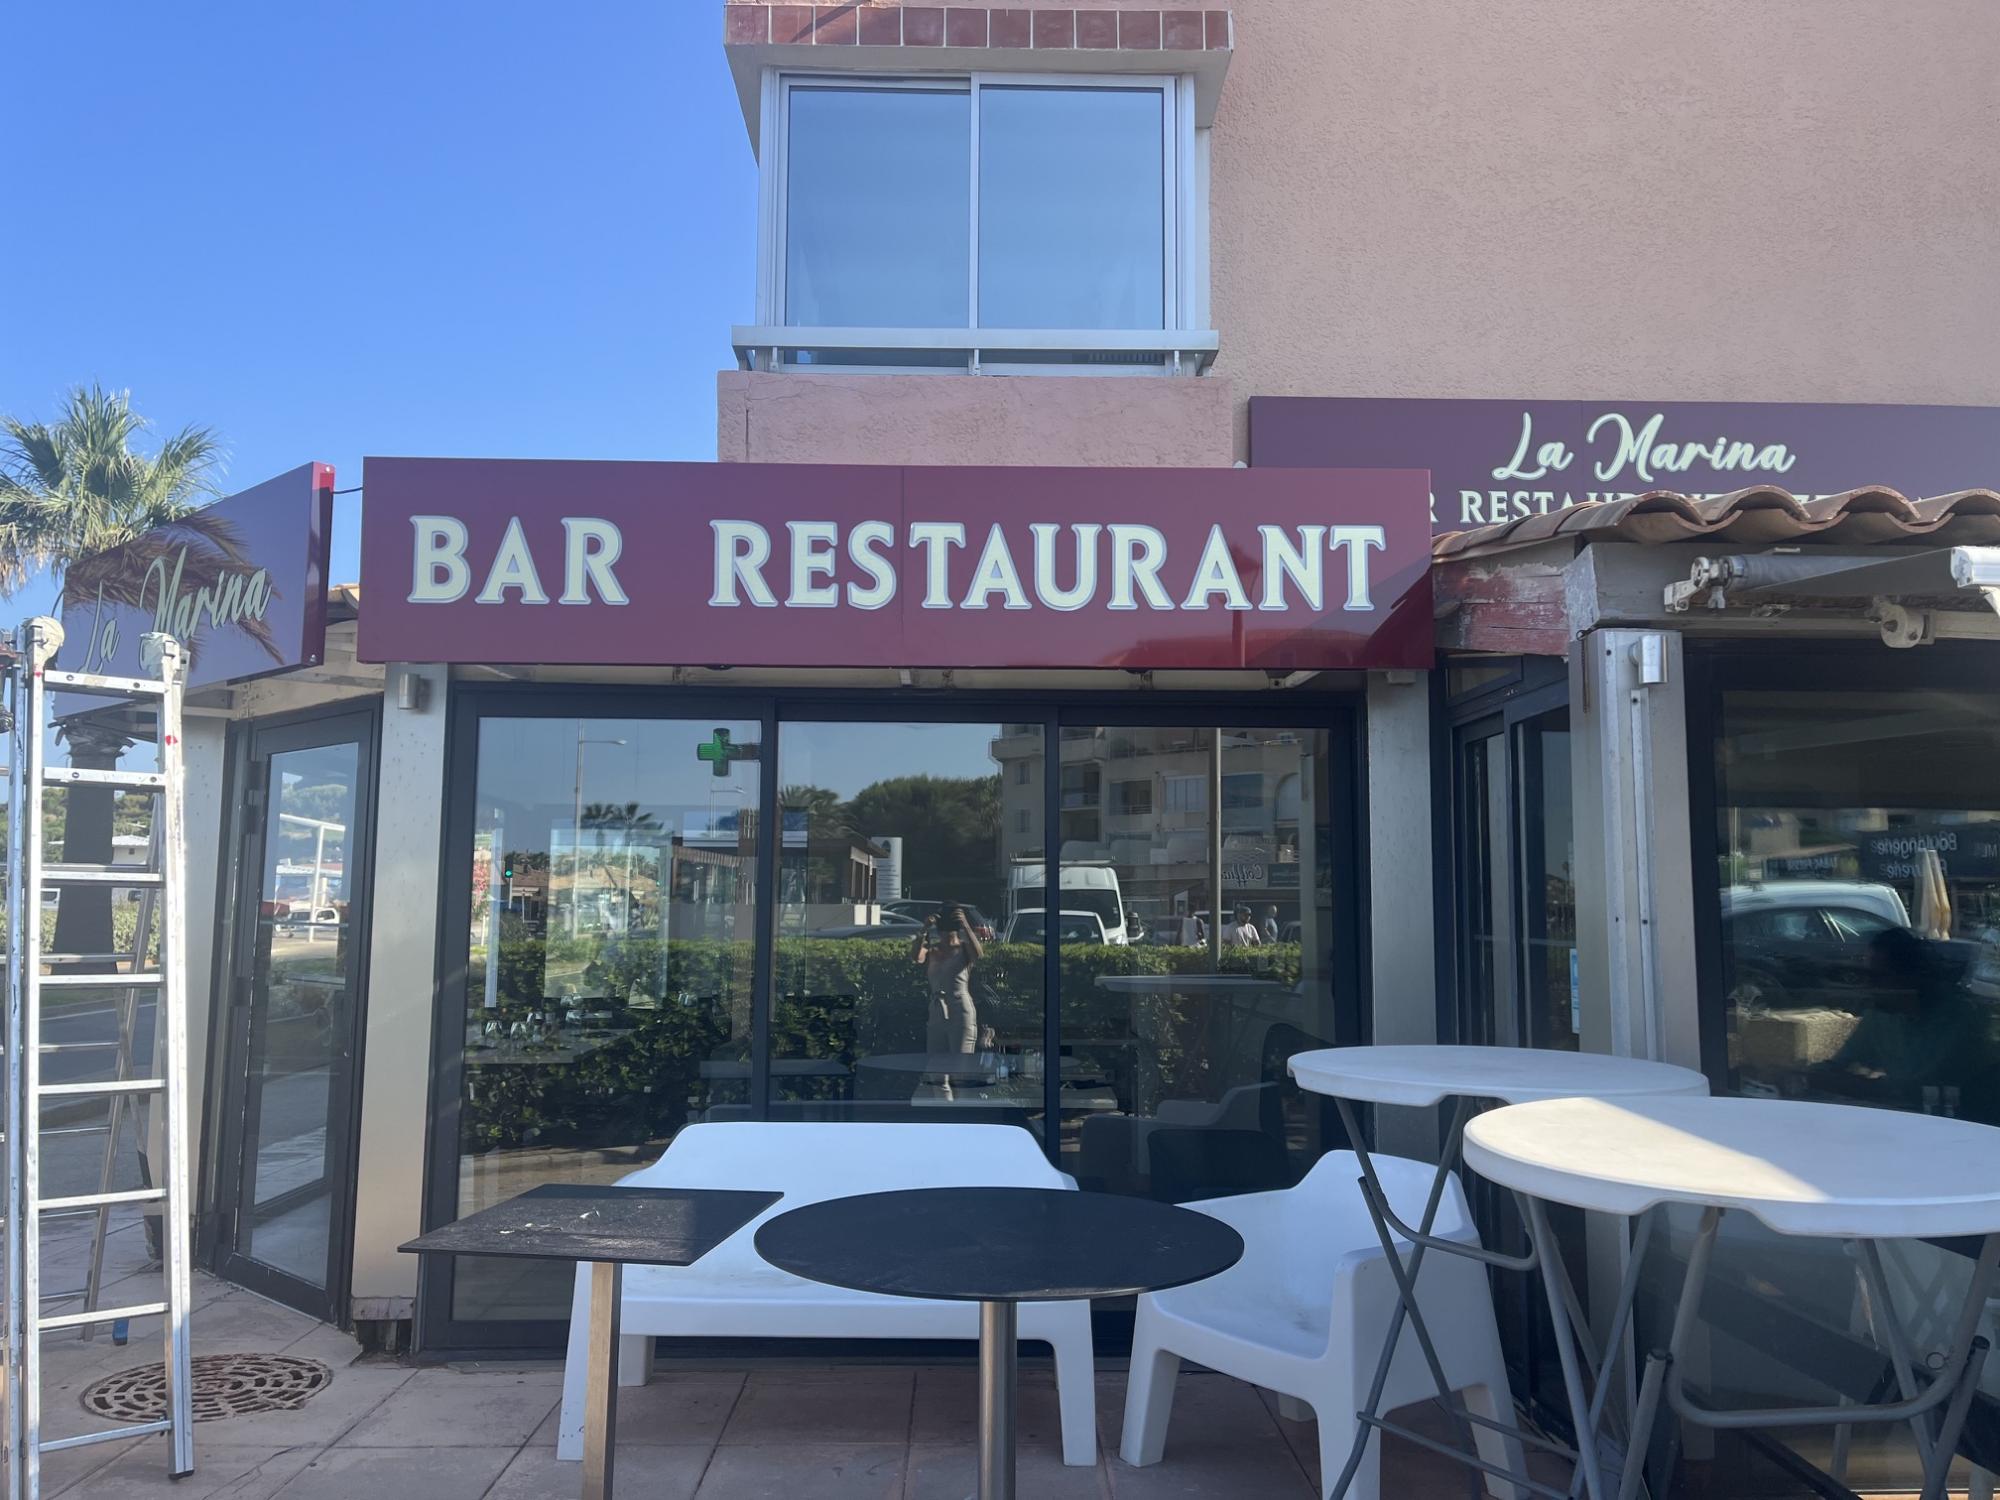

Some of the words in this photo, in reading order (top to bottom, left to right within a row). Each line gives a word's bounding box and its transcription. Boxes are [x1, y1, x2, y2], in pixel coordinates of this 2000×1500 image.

[1491, 411, 1574, 481] La
[1586, 412, 1797, 484] Marina
[78, 580, 120, 673] La
[139, 545, 272, 671] Marina
[407, 516, 630, 605] BAR
[708, 519, 1387, 611] RESTAURANT
